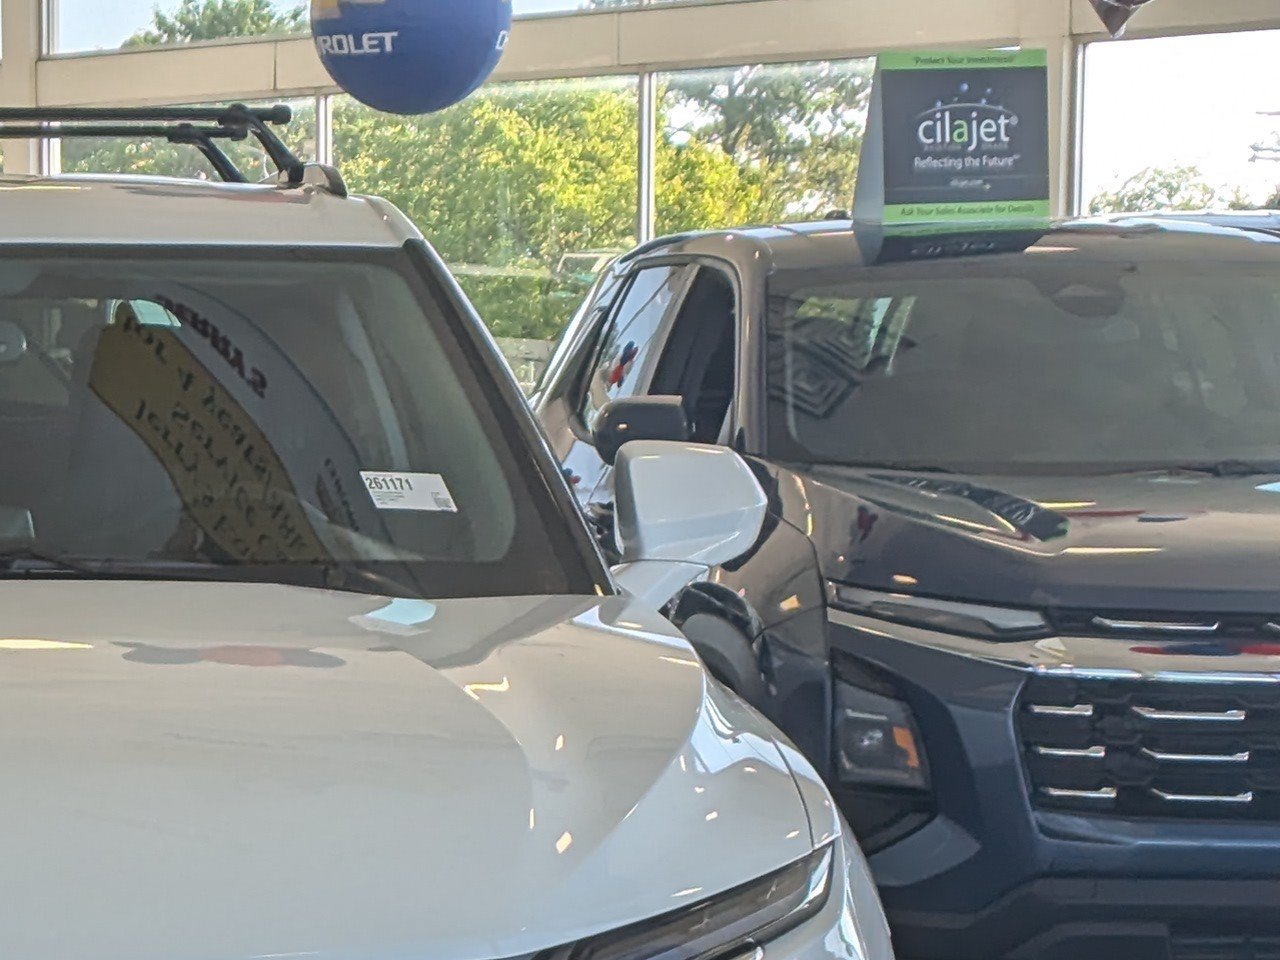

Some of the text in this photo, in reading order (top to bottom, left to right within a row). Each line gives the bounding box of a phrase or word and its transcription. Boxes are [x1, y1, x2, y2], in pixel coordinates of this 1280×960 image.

[914, 157, 963, 169] Reflecting
[964, 157, 981, 167] the
[365, 477, 413, 491] 261171
